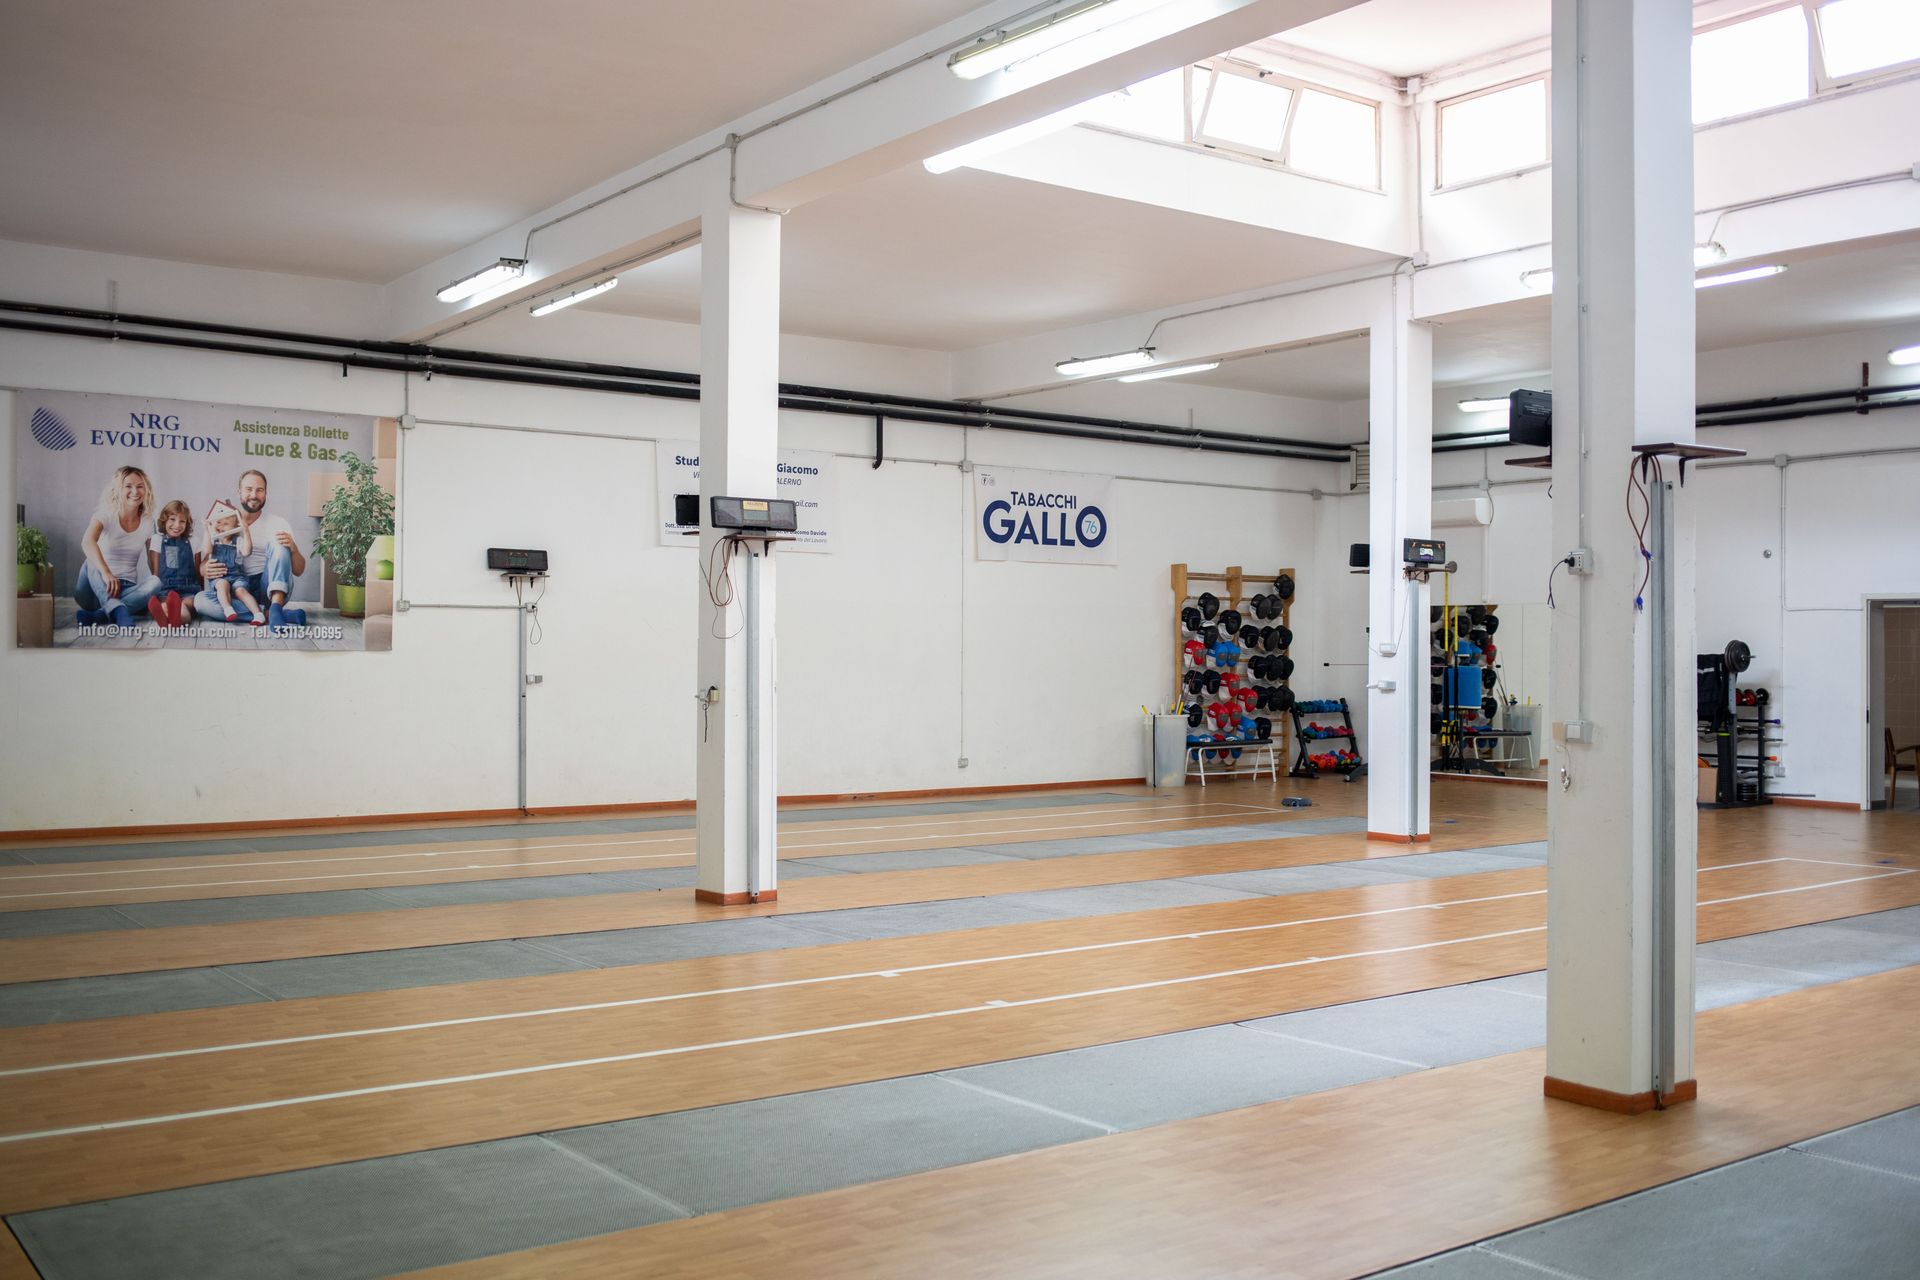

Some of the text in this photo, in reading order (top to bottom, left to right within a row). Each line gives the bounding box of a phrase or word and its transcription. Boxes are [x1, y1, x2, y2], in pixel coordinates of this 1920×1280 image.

[129, 412, 180, 431] NRG
[233, 419, 349, 441] Assistenza Bollette
[90, 429, 221, 453] EVOLUTION
[244, 438, 337, 461] Luce & Gas
[675, 455, 819, 476] Stud Giacomo
[777, 477, 802, 486] ALERNO
[795, 500, 819, 508] ail.com
[1010, 491, 1077, 510] TABACCHI
[983, 500, 1107, 548] GALLO
[1085, 520, 1098, 534] 76
[78, 622, 237, 640] info@nrg-evolution.com
[250, 626, 271, 639] Tel.
[274, 626, 343, 640] 3311340695
